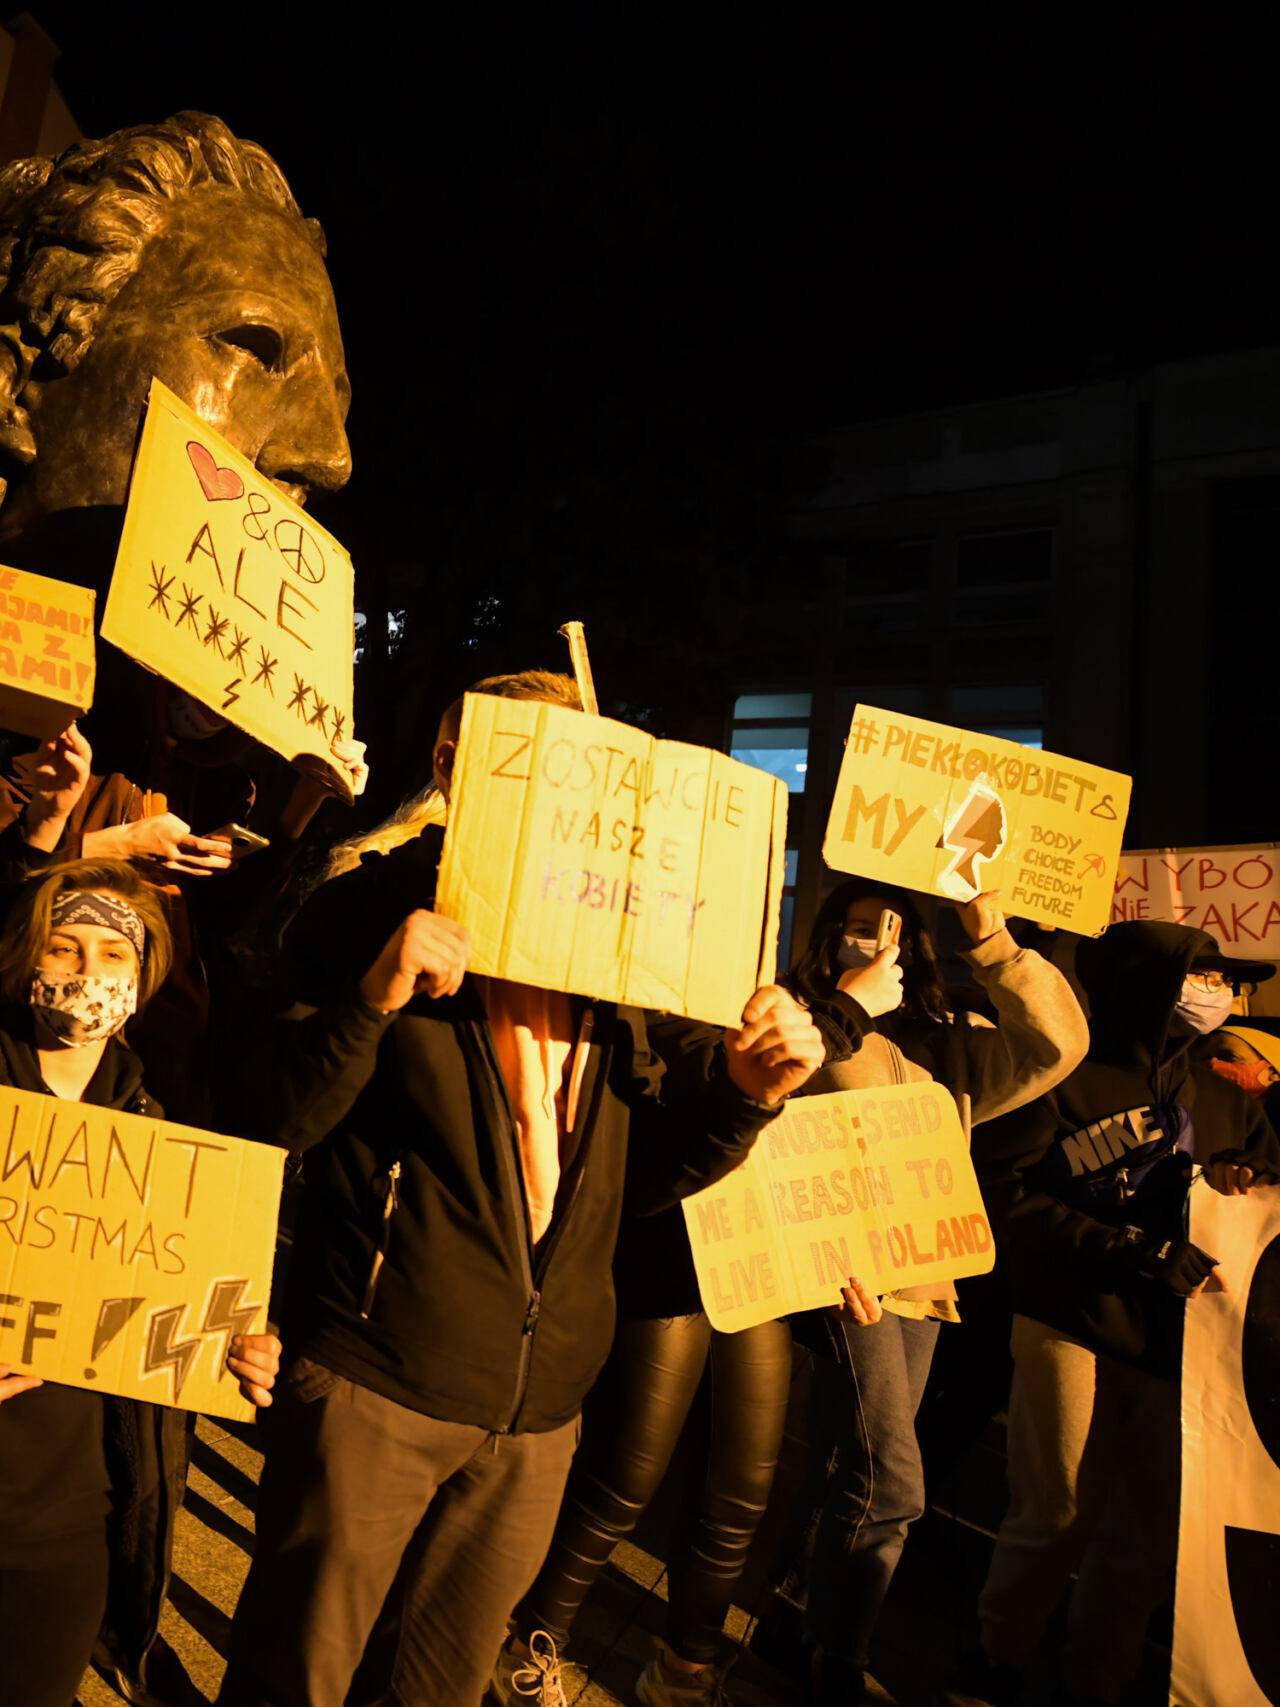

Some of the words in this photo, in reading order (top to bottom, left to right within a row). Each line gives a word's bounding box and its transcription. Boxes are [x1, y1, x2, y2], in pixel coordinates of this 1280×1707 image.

[185, 521, 320, 652] ALE
[43, 633, 70, 661] Z
[491, 731, 744, 828] ZOSTAWCIE
[550, 810, 681, 873] NASZE
[840, 784, 927, 857] MY
[1031, 825, 1082, 854] BODY
[541, 859, 705, 938] KOBIETY
[1011, 887, 1075, 918] FUTURE
[1017, 869, 1082, 899] FREEDOM
[1, 1105, 227, 1217] WANT
[1061, 1106, 1163, 1177] NIKE
[696, 1197, 735, 1244] ME
[744, 1188, 764, 1233] A
[770, 1165, 895, 1225] REASON
[906, 1158, 954, 1199] TO
[709, 1252, 777, 1313] LIVE
[810, 1236, 855, 1287] IN
[867, 1212, 993, 1277] POLAND
